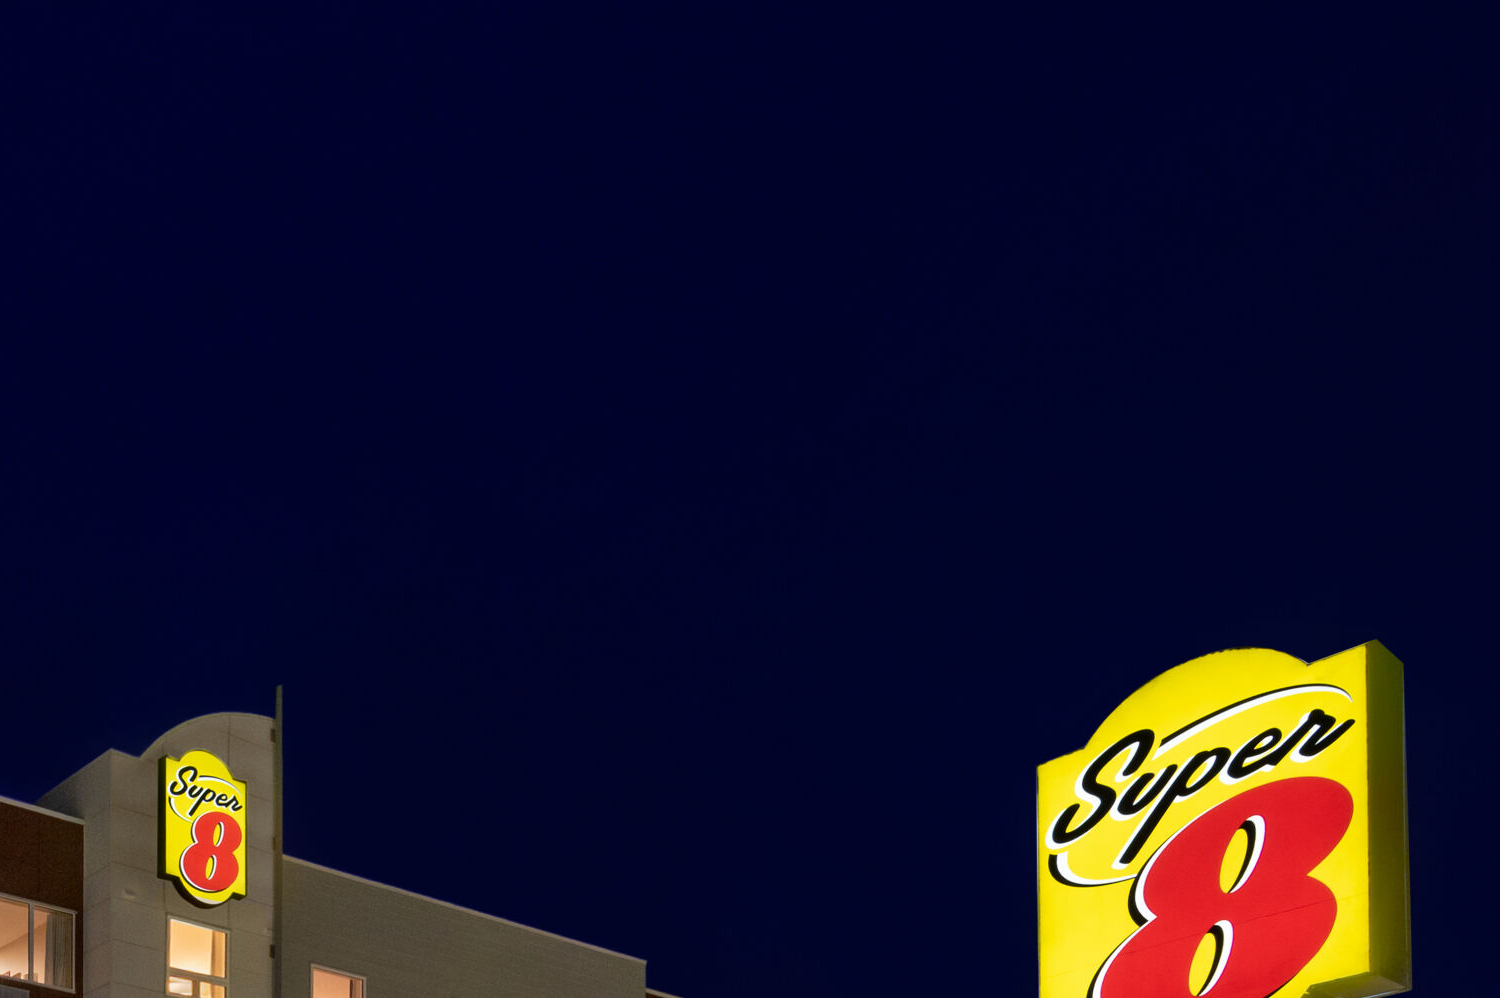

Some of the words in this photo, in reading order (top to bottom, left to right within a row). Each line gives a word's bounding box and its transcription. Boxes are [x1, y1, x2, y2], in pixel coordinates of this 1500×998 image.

[168, 765, 243, 817] Super
[1048, 708, 1356, 868] Super
[179, 810, 243, 893] 8
